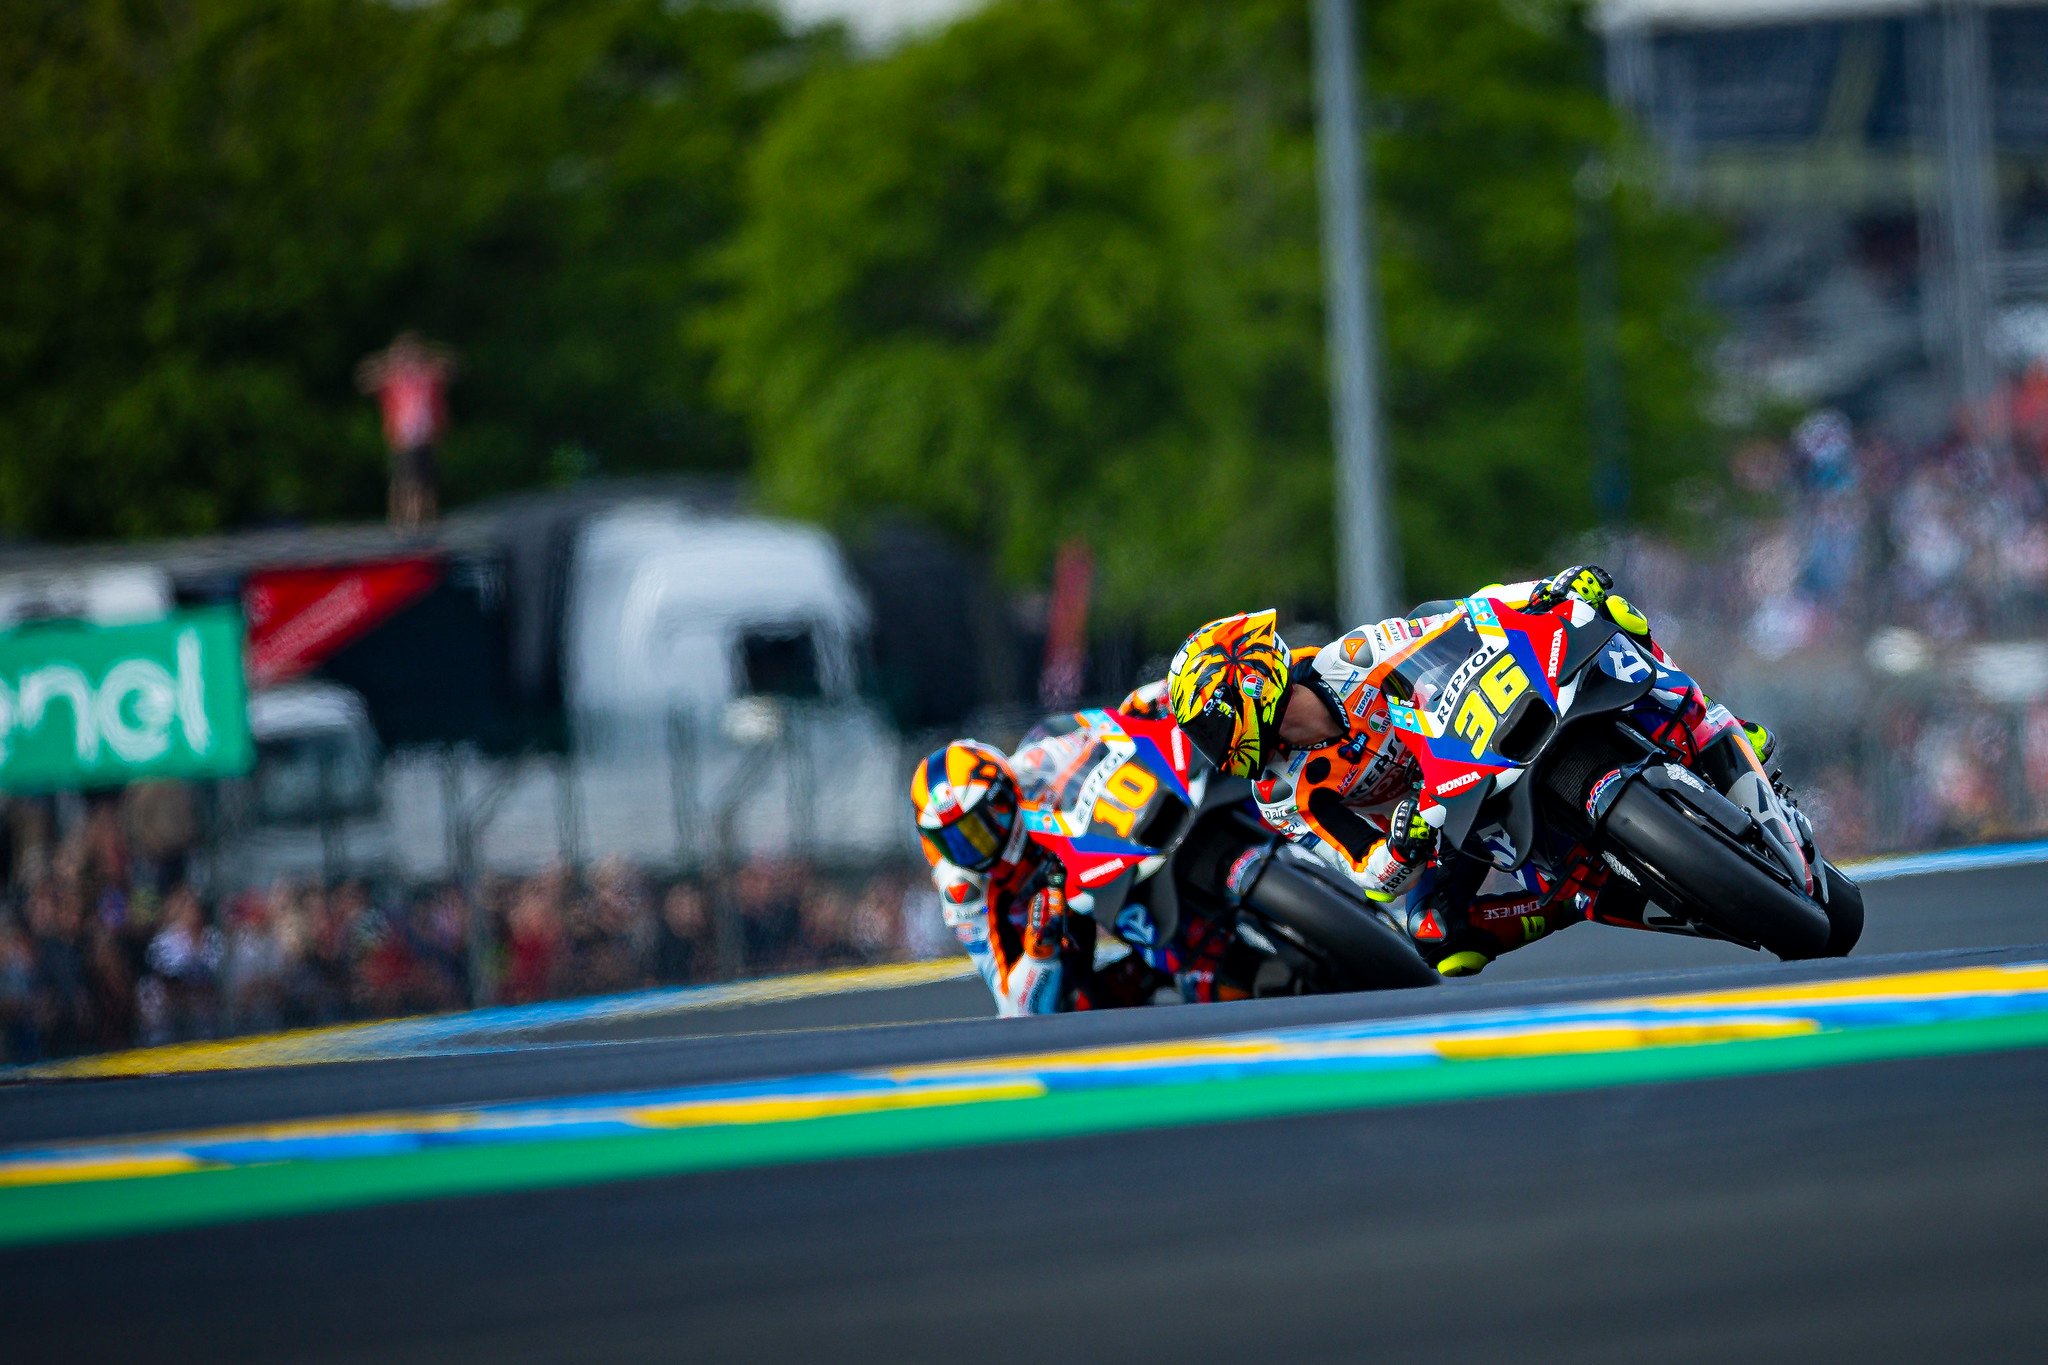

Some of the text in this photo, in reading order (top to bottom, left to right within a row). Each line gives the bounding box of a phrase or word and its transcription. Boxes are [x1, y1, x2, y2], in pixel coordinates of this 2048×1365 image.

[1547, 628, 1563, 678] HONDA
[0, 627, 209, 769] nel
[1355, 686, 1374, 715] REPSOL
[1437, 645, 1499, 725] REPSOL
[1454, 653, 1530, 760] 36
[1093, 761, 1158, 838] 10
[1436, 771, 1481, 795] HONDA
[1381, 864, 1415, 894] REPSO
[1483, 901, 1540, 920] DAINESE
